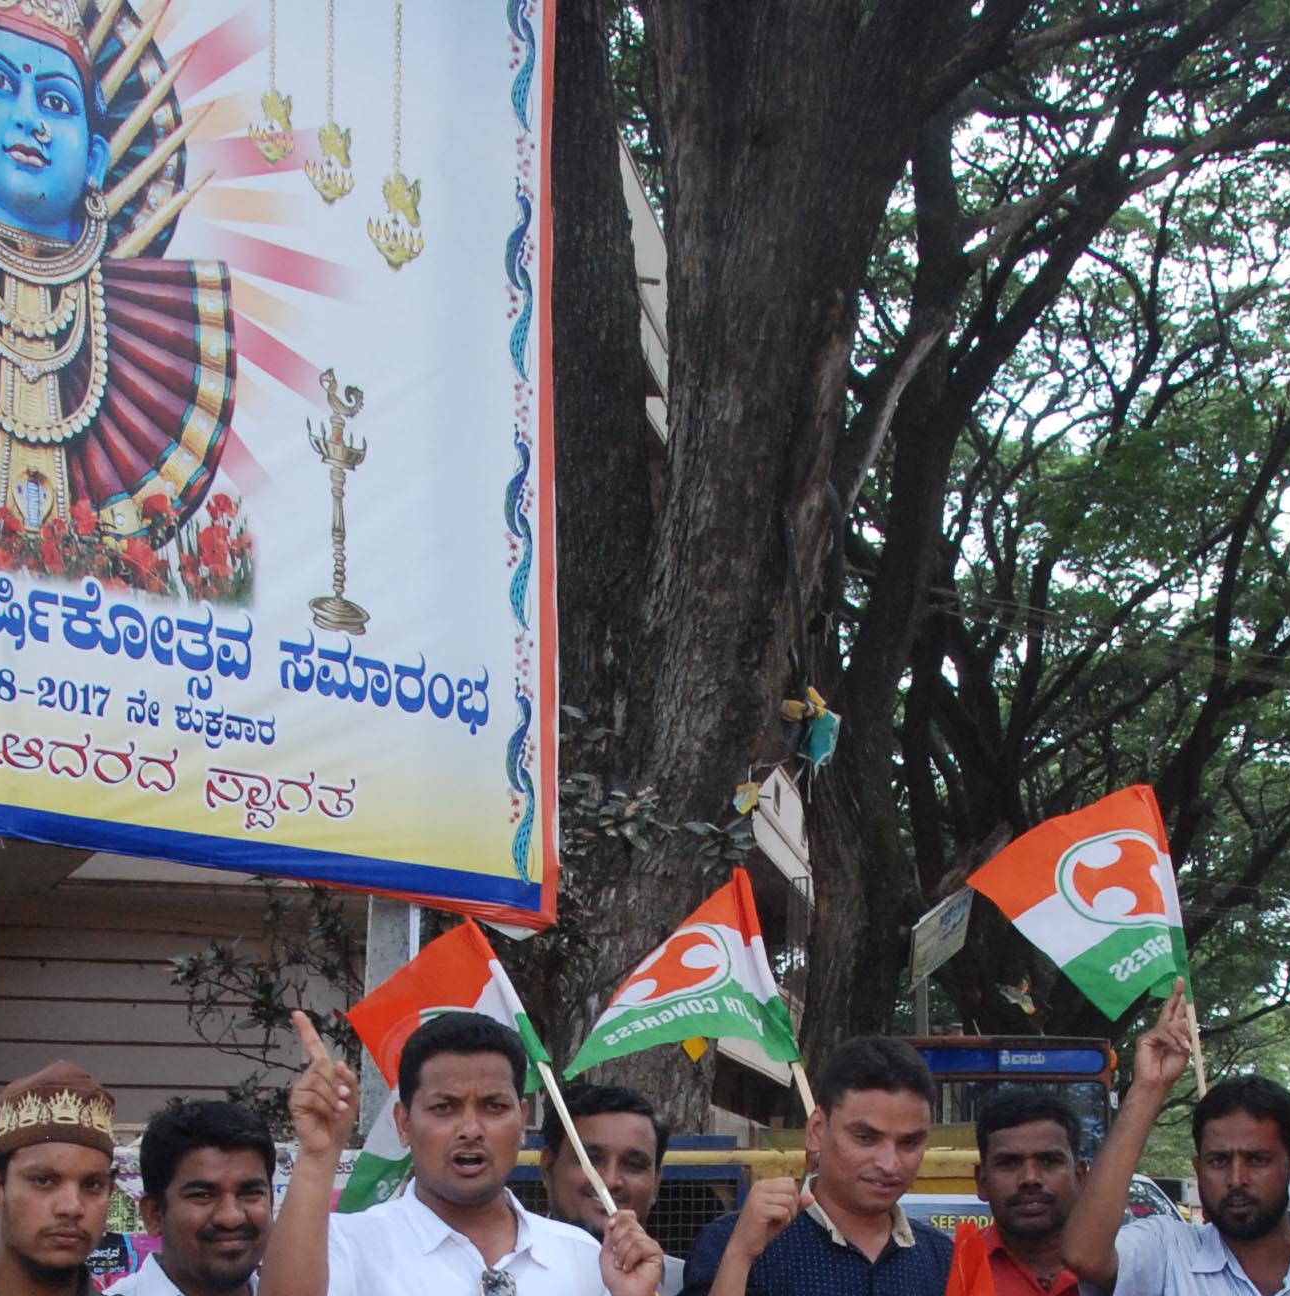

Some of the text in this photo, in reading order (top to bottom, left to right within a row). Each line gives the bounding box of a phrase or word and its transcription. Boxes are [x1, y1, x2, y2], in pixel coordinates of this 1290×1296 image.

[280, 629, 489, 736] ಸಮಾರಂಭ
[126, 690, 160, 727] ನೇ
[175, 703, 276, 749] ಶುಕ್ರವಾರ
[207, 767, 357, 830] ಸ್ವಾಗತ
[930, 1215, 955, 1229] SEE
